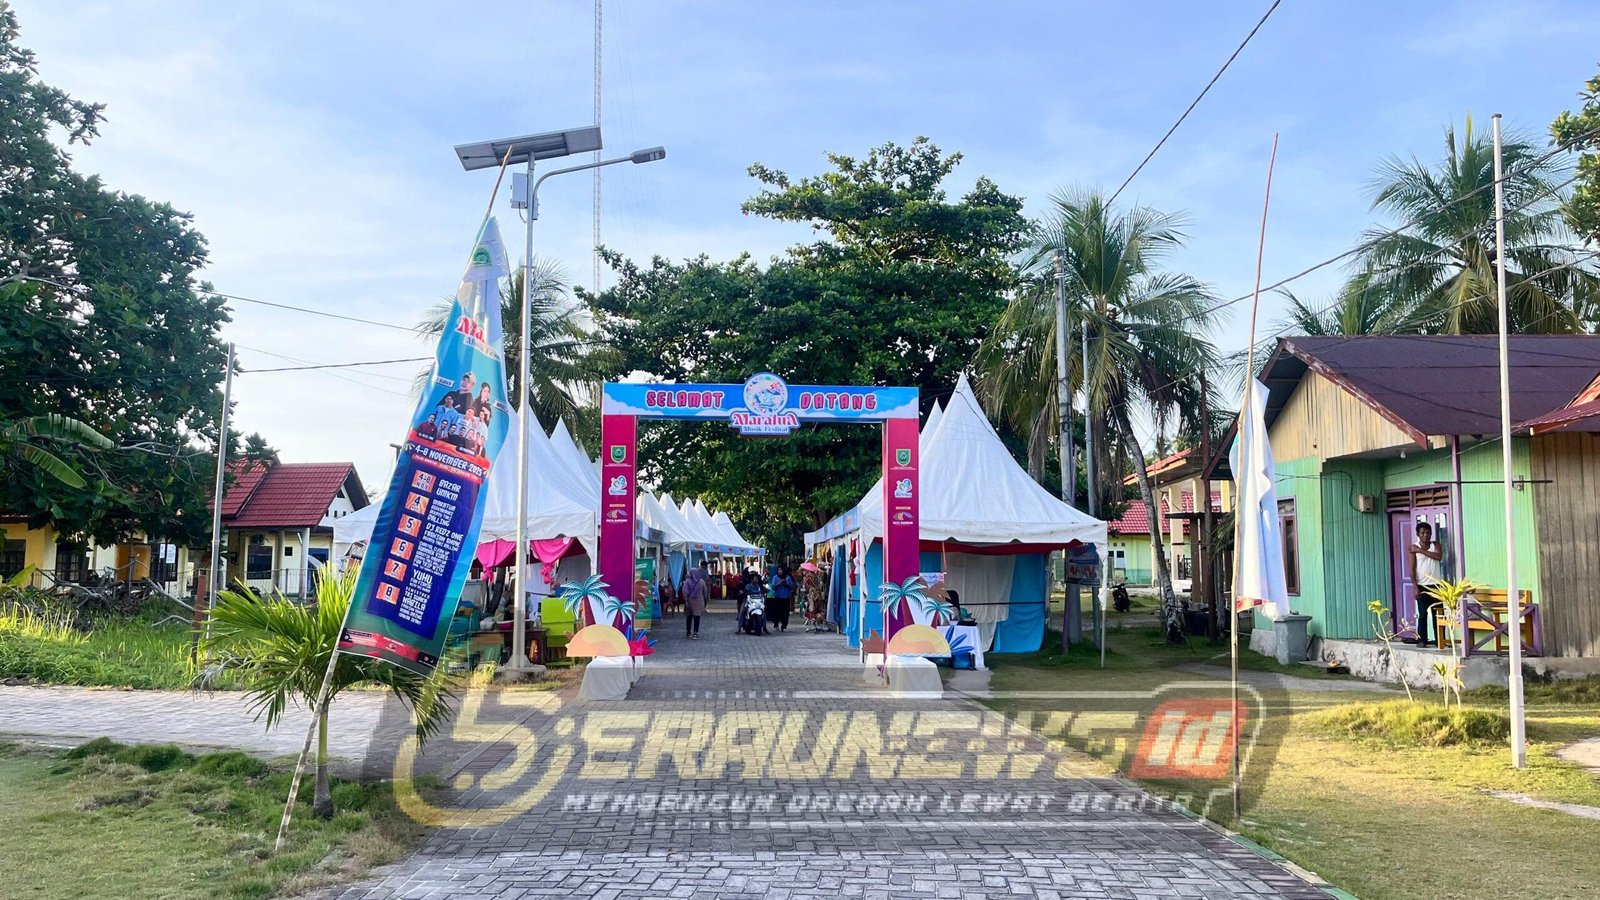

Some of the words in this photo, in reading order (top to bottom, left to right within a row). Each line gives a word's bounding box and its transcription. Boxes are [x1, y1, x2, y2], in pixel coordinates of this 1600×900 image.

[646, 390, 724, 408] SELAMAT
[800, 392, 877, 410] DATANG
[415, 444, 428, 456] 4-8
[429, 449, 468, 470] NOVEMBER
[468, 461, 483, 477] 2025
[438, 479, 462, 493] BAZAR
[414, 495, 421, 506] 4
[436, 488, 459, 501] UMKM
[406, 518, 414, 529] 5
[425, 522, 435, 531] DJ
[450, 532, 464, 541] ONE
[399, 541, 407, 552] 6
[391, 562, 399, 573] 7
[385, 586, 393, 597] 8
[402, 596, 426, 611] NABILA
